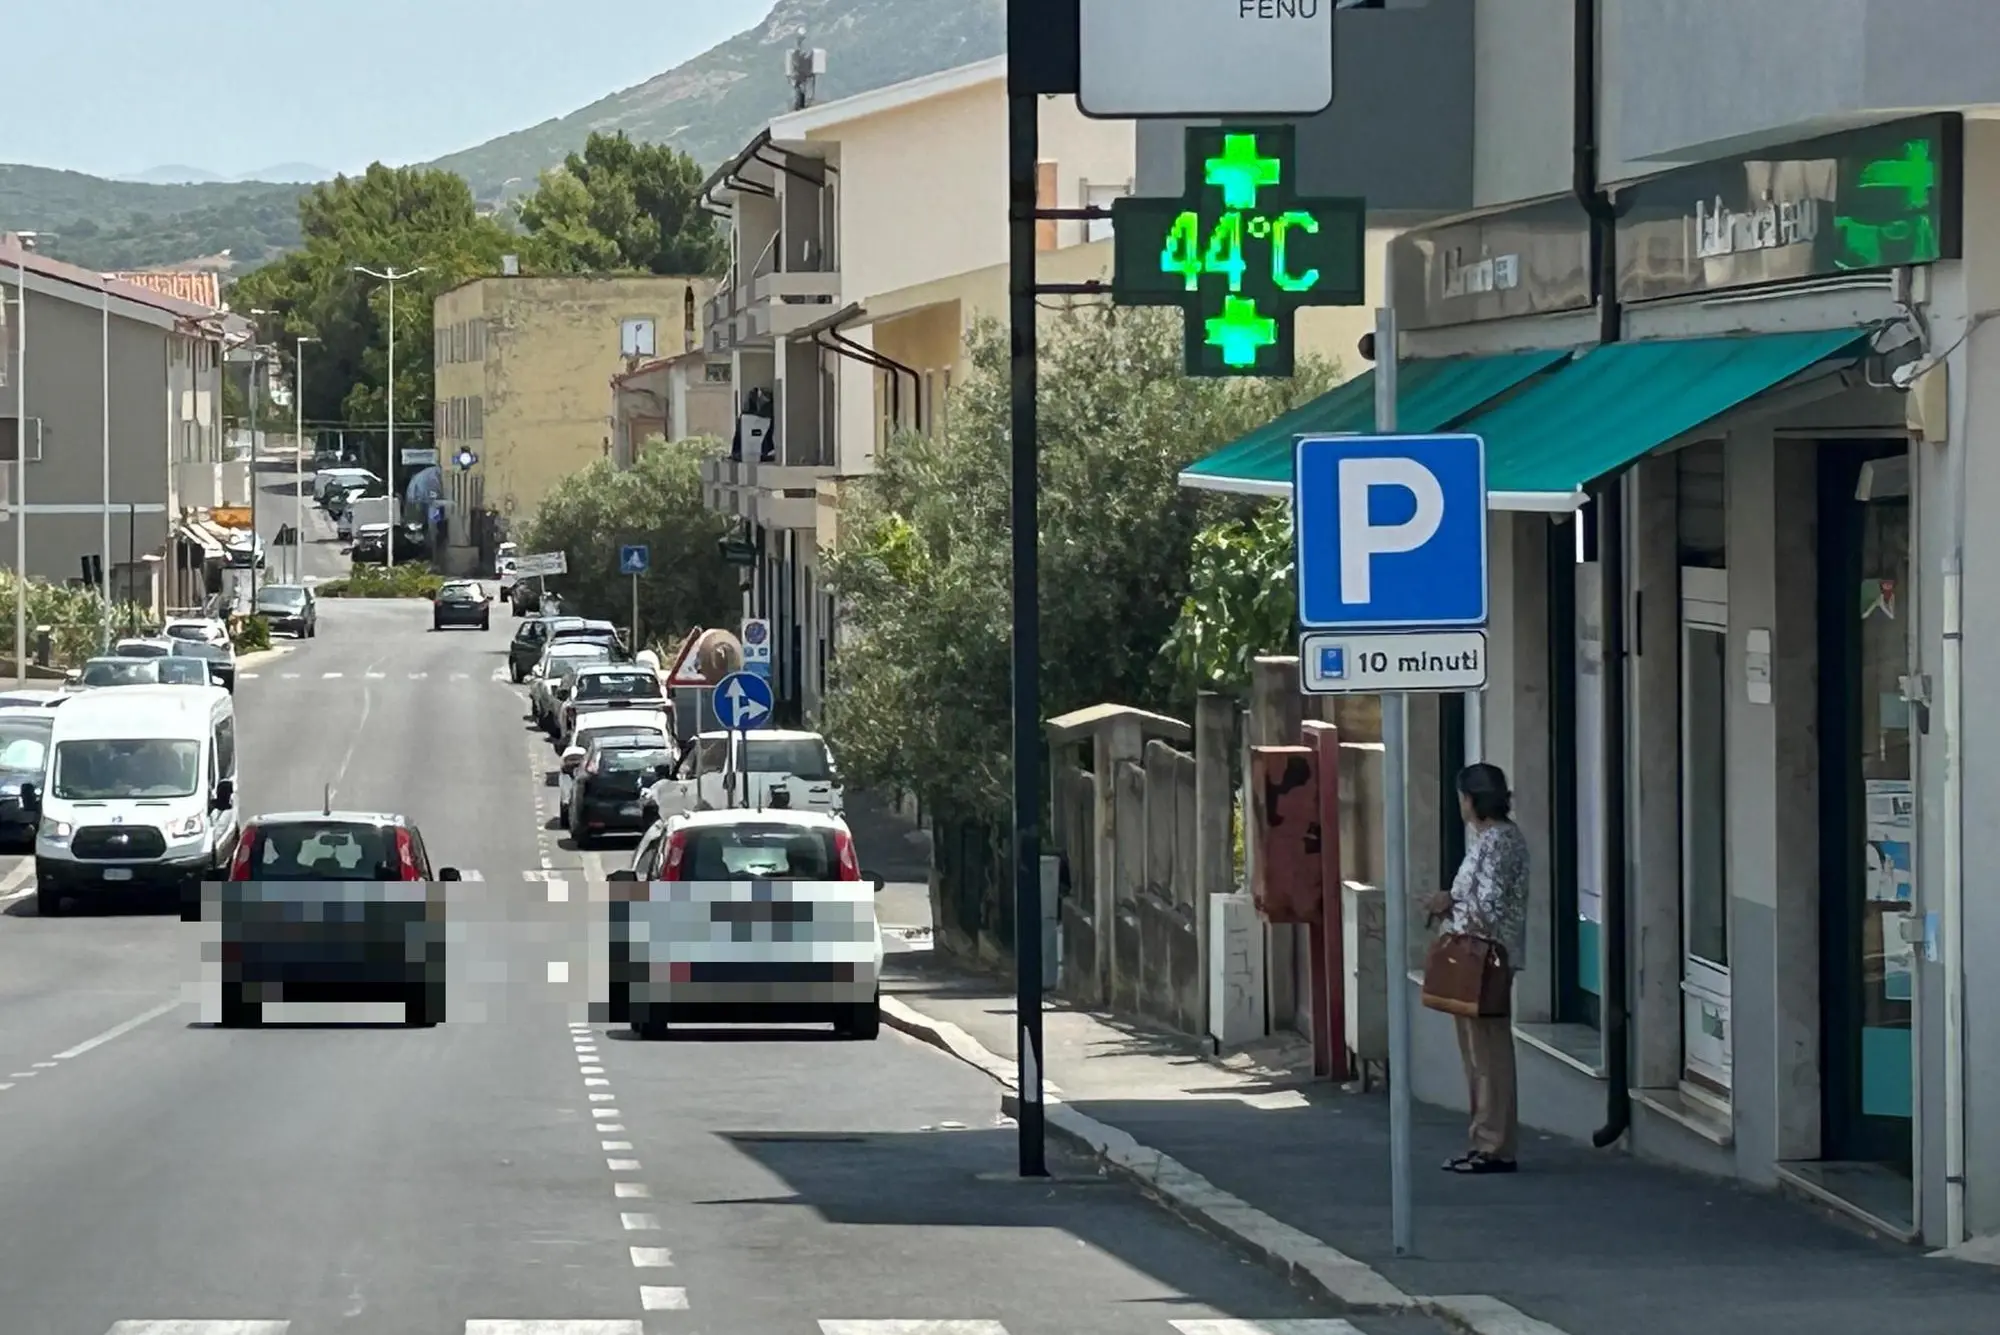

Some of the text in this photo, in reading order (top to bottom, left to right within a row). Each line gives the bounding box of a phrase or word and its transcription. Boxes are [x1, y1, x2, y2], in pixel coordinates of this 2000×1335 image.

[1240, 0, 1317, 18] FENU
[1161, 212, 1319, 291] 44°C
[1338, 457, 1444, 604] P
[1358, 652, 1388, 673] 10
[1398, 650, 1478, 672] minuti
